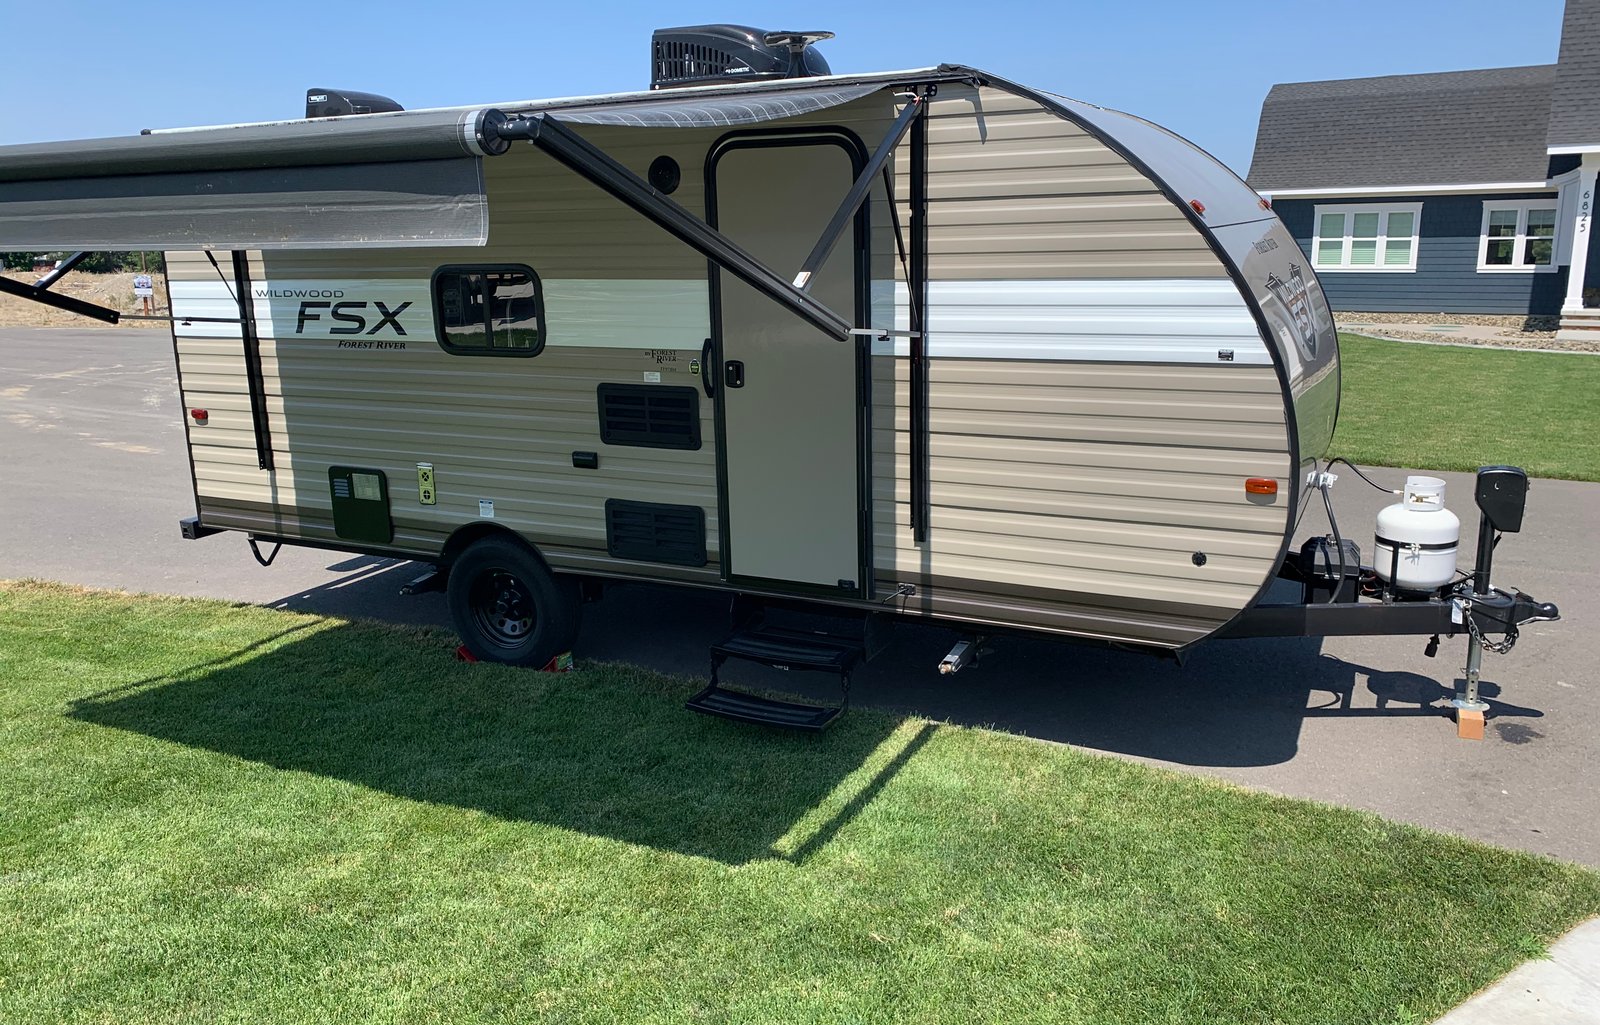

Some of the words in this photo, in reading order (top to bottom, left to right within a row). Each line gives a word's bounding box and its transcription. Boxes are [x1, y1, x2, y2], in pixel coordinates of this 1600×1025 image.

[1580, 190, 1590, 233] 6825
[255, 289, 344, 298] WILDWOOD
[296, 301, 413, 336] FSX
[337, 340, 374, 349] FOREST
[376, 341, 406, 350] RIVER
[651, 350, 677, 358] FOREST
[656, 355, 677, 363] RIVER
